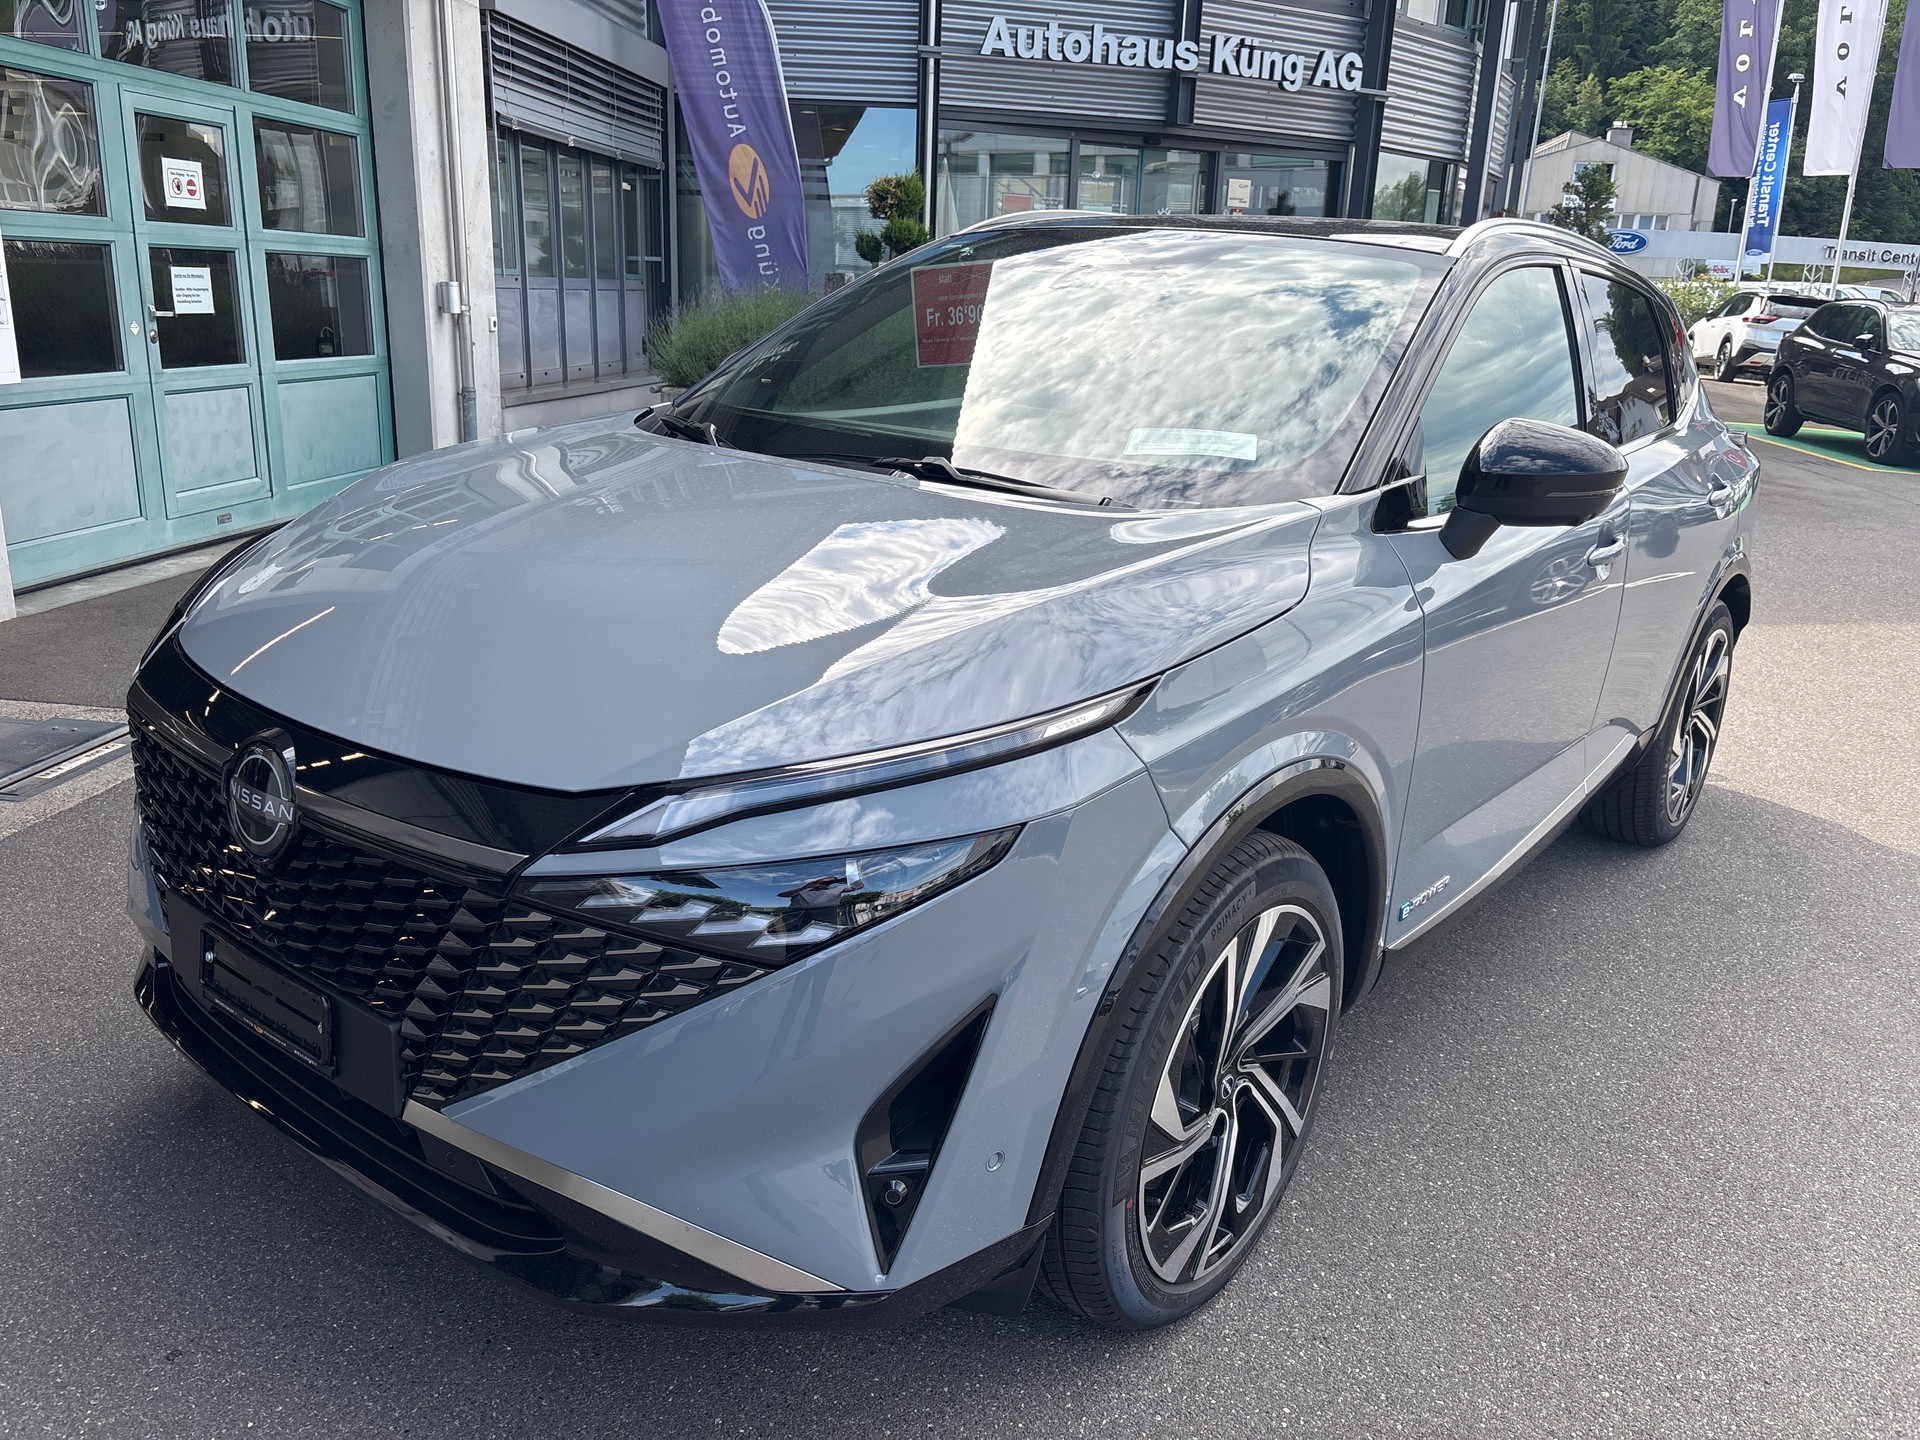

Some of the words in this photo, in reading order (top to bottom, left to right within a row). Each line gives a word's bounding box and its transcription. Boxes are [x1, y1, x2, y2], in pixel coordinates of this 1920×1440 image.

[980, 15, 1199, 71] Autohaus
[1211, 33, 1305, 92] Küng
[1311, 49, 1363, 91] AG
[1609, 234, 1640, 250] Ford
[1825, 245, 1877, 262] Transit
[926, 307, 944, 328] Fr.
[230, 778, 294, 821] NISSAN
[1210, 894, 1249, 941] PRIMACY
